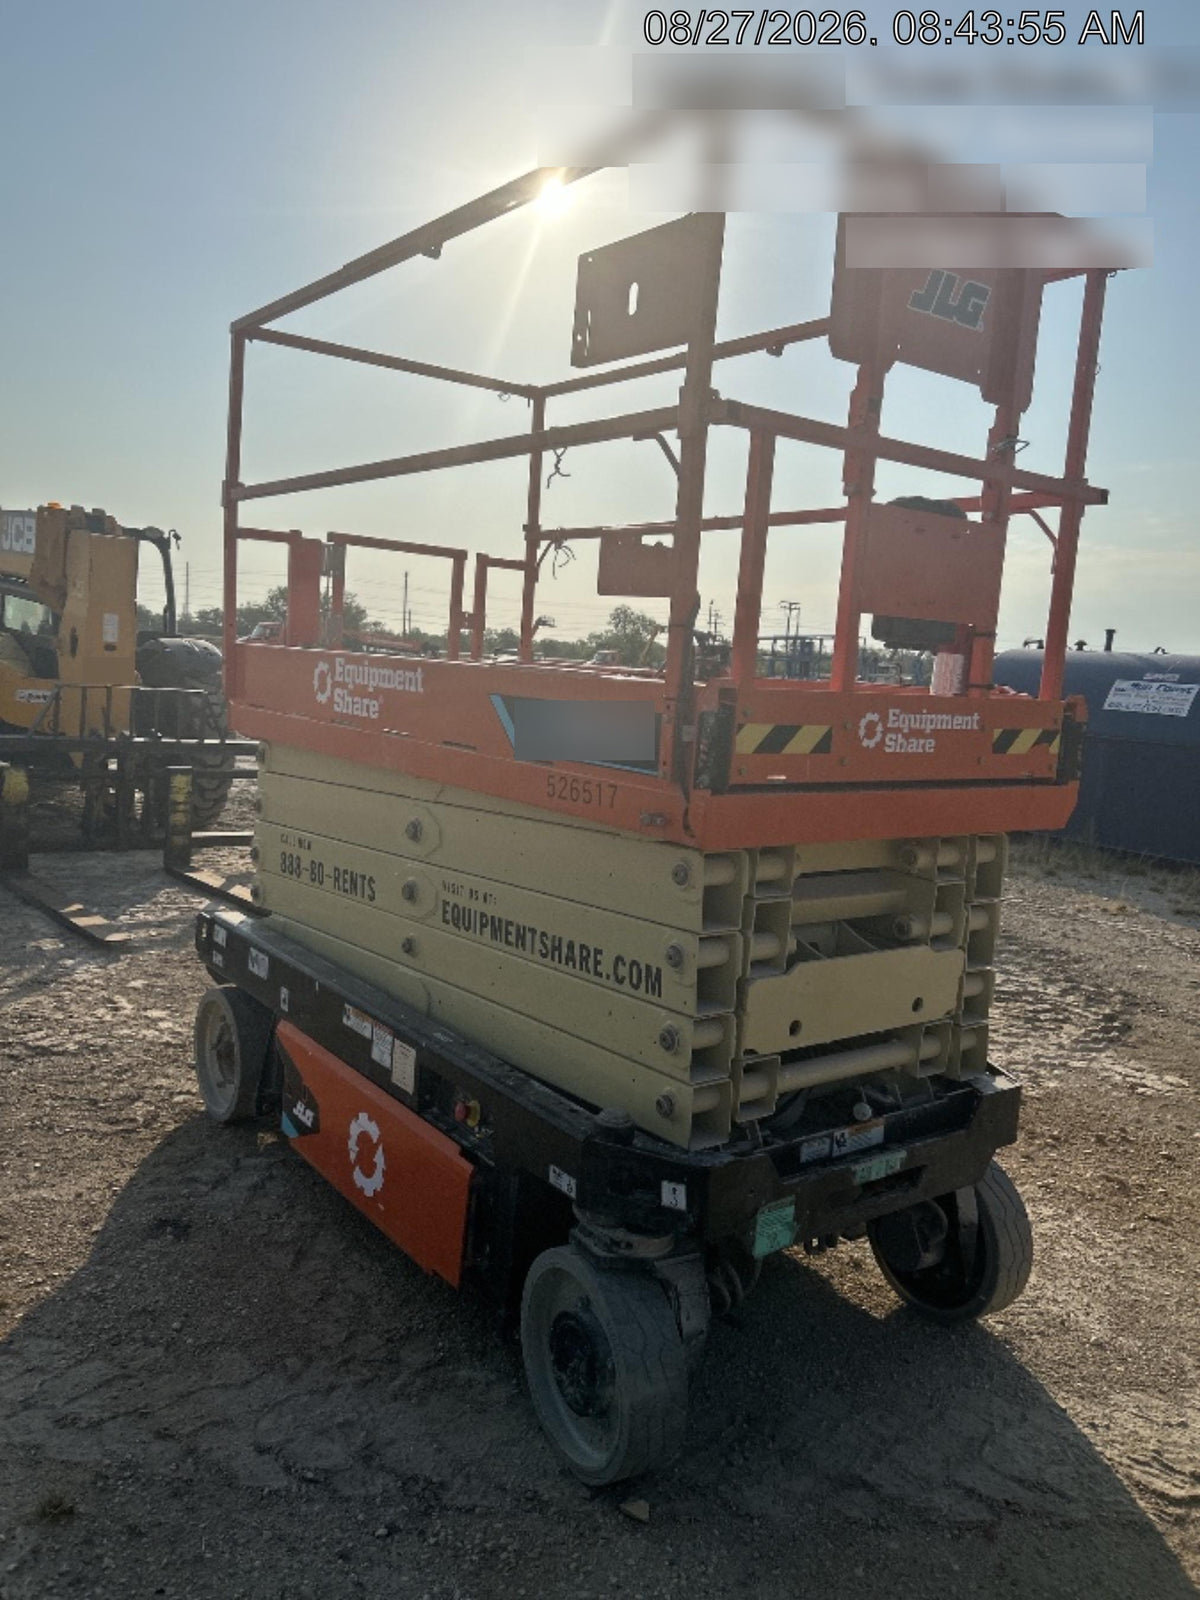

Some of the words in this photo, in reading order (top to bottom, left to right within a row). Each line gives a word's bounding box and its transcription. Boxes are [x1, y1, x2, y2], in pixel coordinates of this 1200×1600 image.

[907, 268, 992, 331] JLG
[334, 657, 424, 693] Equipment
[333, 687, 380, 719] Share
[887, 708, 980, 733] Equipment
[884, 733, 936, 753] Share
[546, 775, 618, 809] 526517
[280, 851, 377, 902] 888-80-RENTS
[441, 899, 663, 999] EQUIPMENTSHARE.COM
